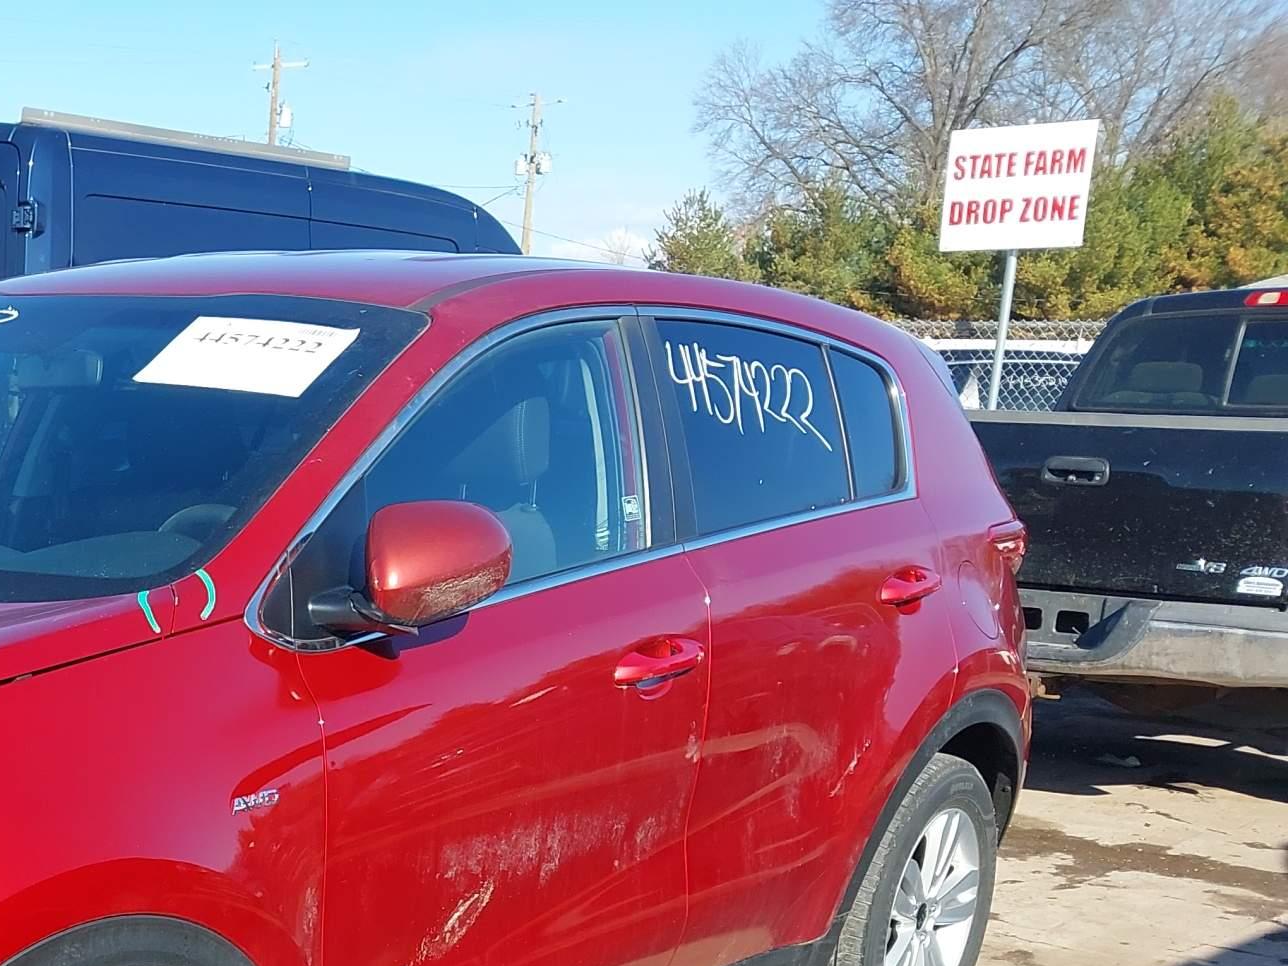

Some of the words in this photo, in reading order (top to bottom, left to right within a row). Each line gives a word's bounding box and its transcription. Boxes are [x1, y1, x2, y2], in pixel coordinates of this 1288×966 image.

[953, 151, 1018, 181] STATE
[1023, 147, 1088, 177] FARM
[948, 198, 1014, 226] DROP
[1019, 194, 1081, 223] ZONE
[192, 331, 324, 354] 44574222
[664, 340, 833, 452] 44574222
[1239, 564, 1288, 578] 4WD
